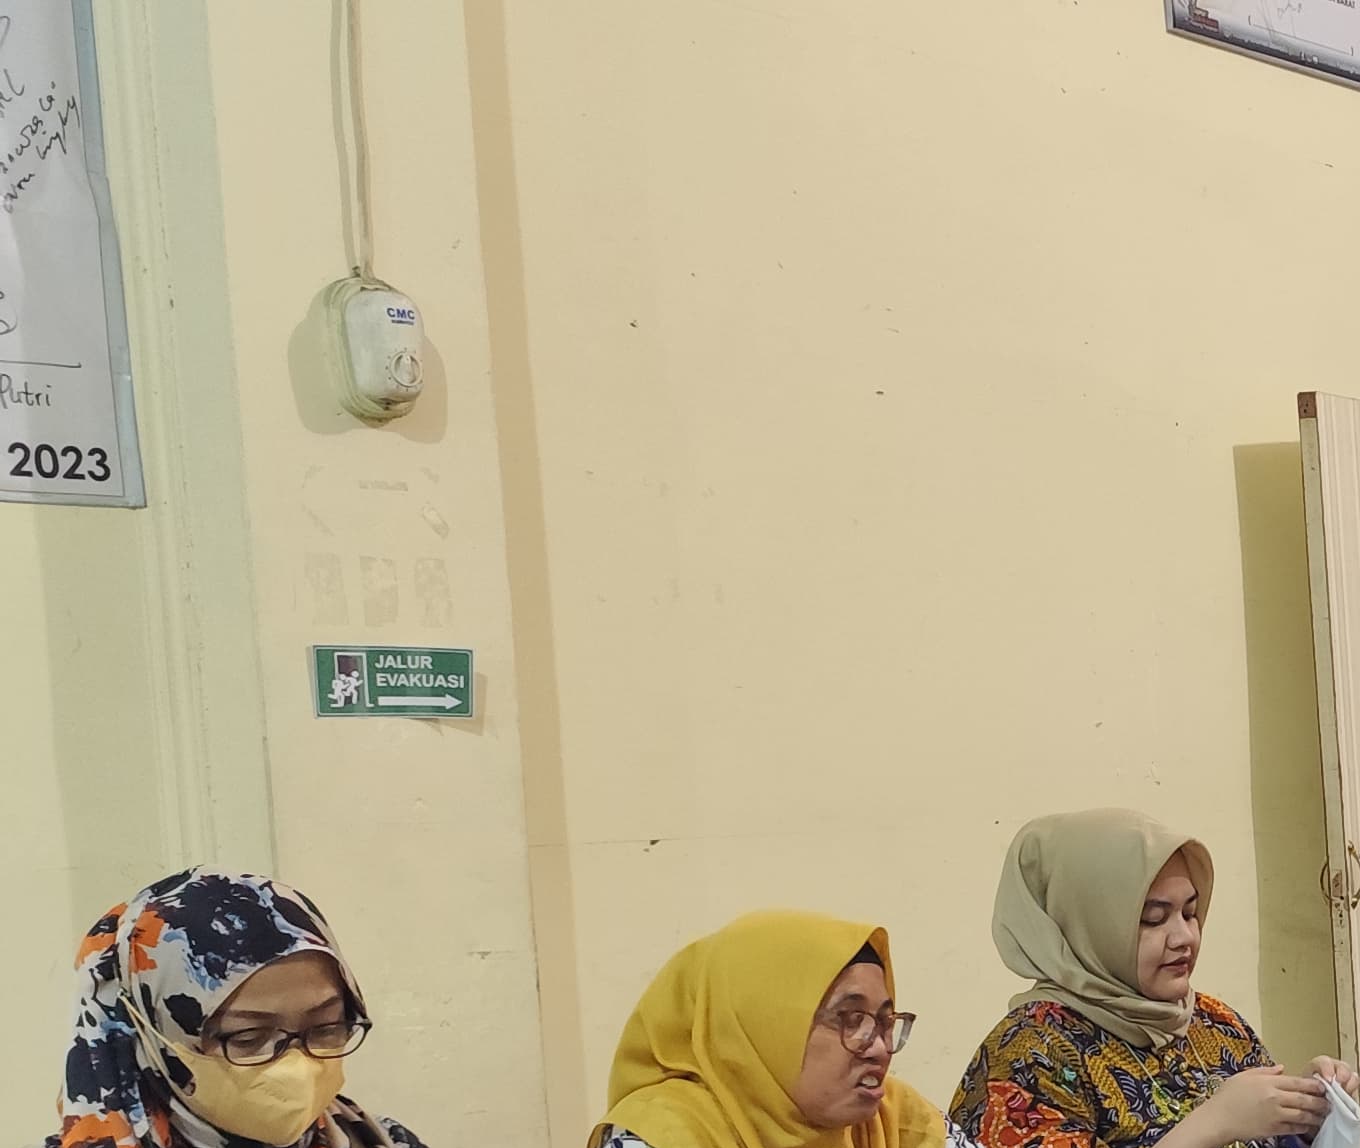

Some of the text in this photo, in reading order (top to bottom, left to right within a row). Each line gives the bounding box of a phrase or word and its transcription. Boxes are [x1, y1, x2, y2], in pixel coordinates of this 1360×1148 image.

[386, 307, 416, 320] CMC
[8, 442, 111, 482] 2023
[375, 654, 433, 669] JALUR
[376, 673, 465, 689] EVAKUASI
